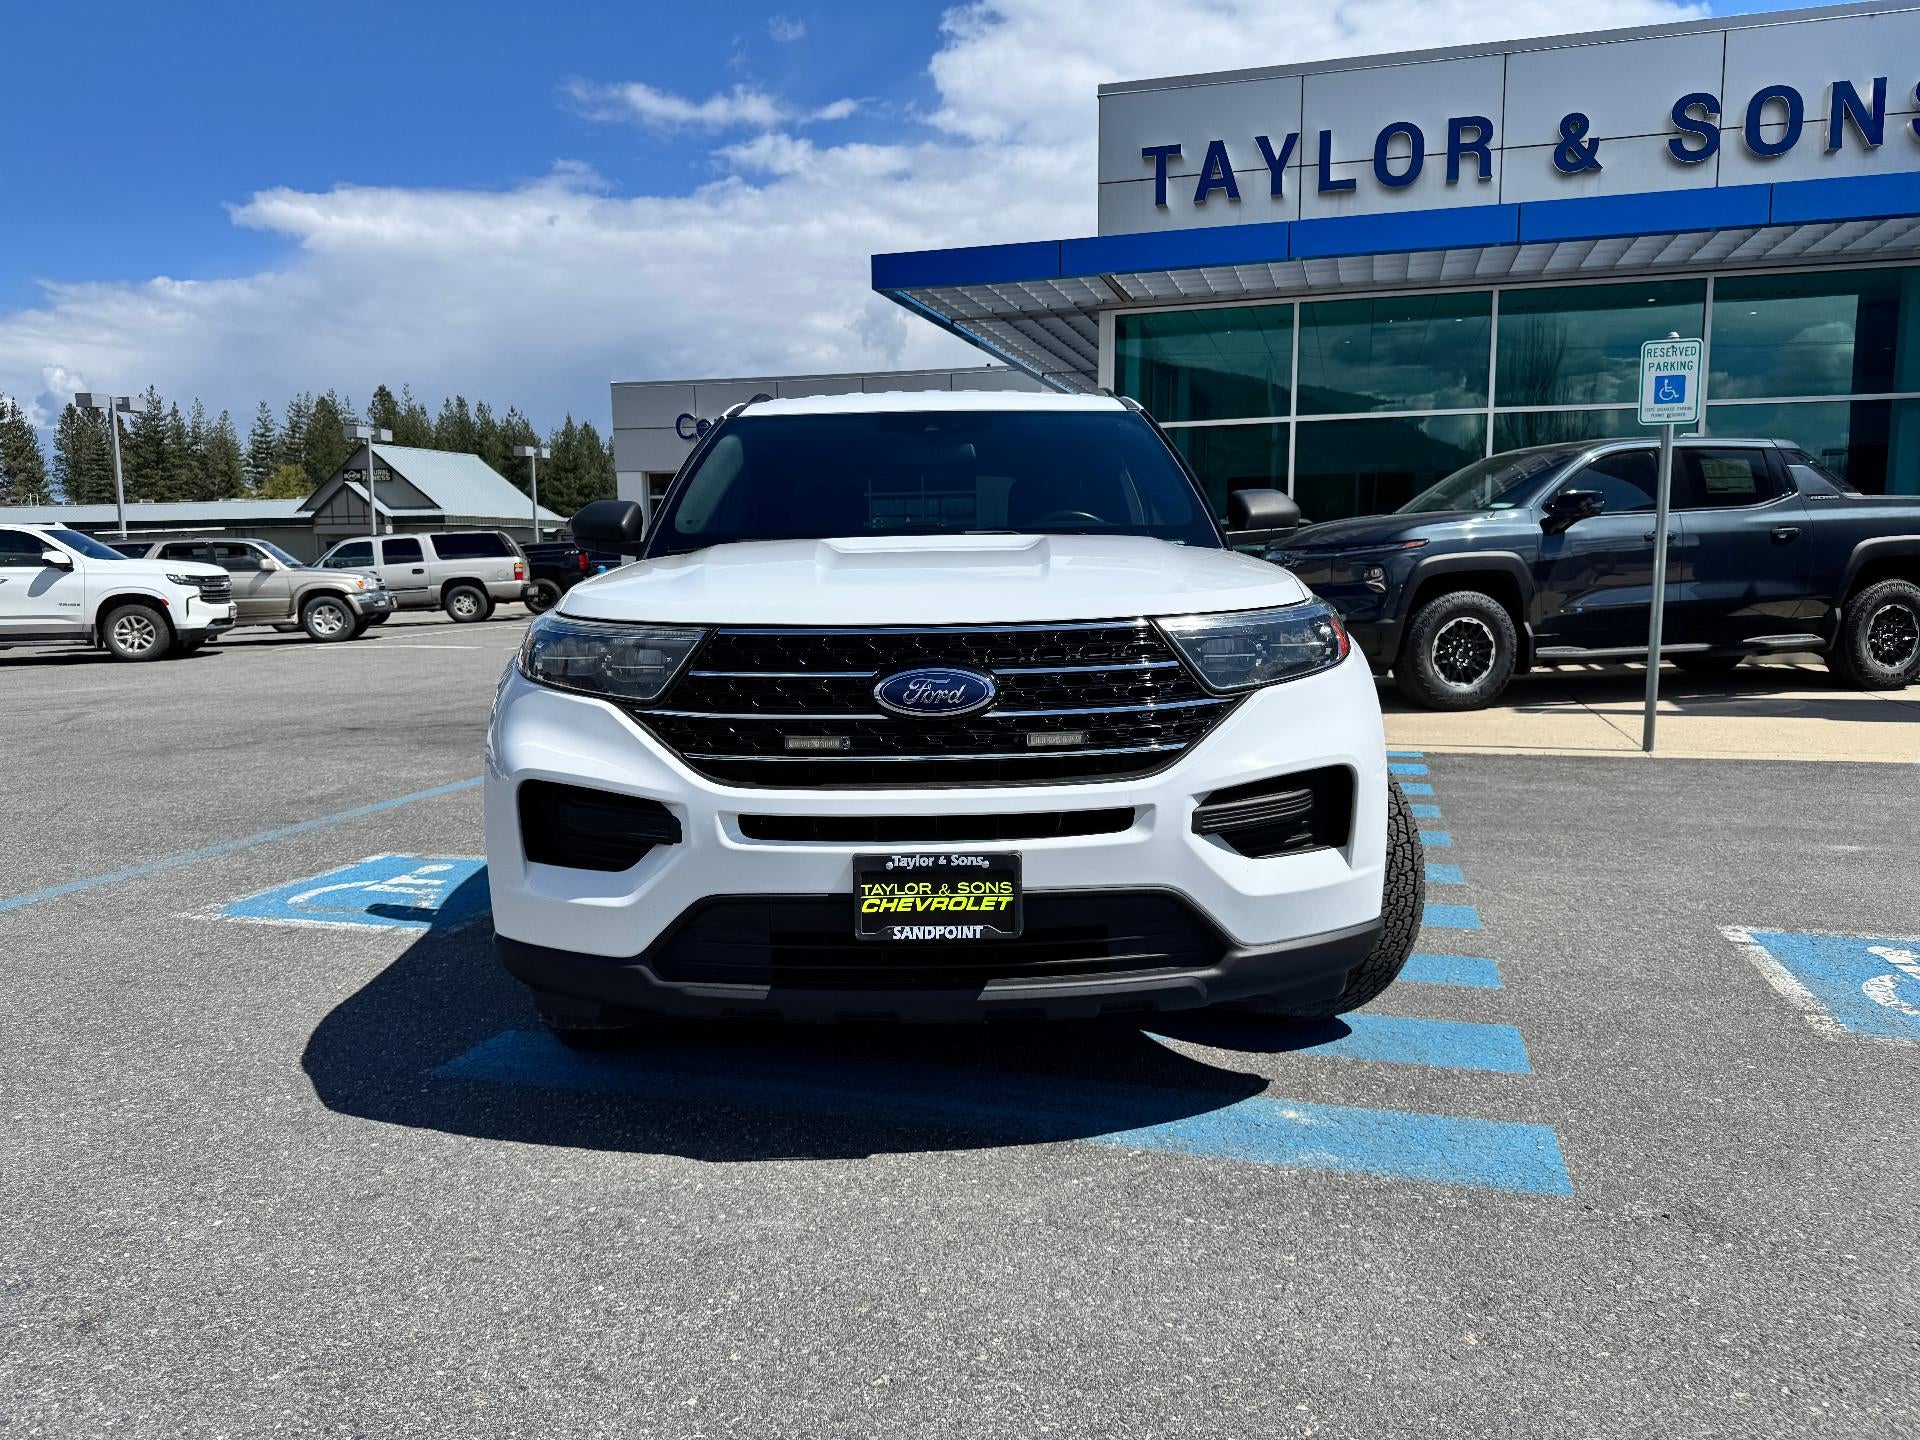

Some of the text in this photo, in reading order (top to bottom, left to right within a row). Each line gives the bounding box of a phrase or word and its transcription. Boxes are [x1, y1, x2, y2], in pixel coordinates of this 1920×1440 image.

[1141, 77, 1920, 207] TAYLOR & SON
[1646, 346, 1697, 358] RESERVED
[1648, 360, 1694, 372] PARKING
[902, 678, 966, 704] Ford
[891, 855, 984, 870] Taylor & Sons
[861, 882, 1013, 896] TAYLOR & SONS
[861, 896, 1014, 913] CHEVROLET
[892, 925, 984, 940] SANDPOINT
